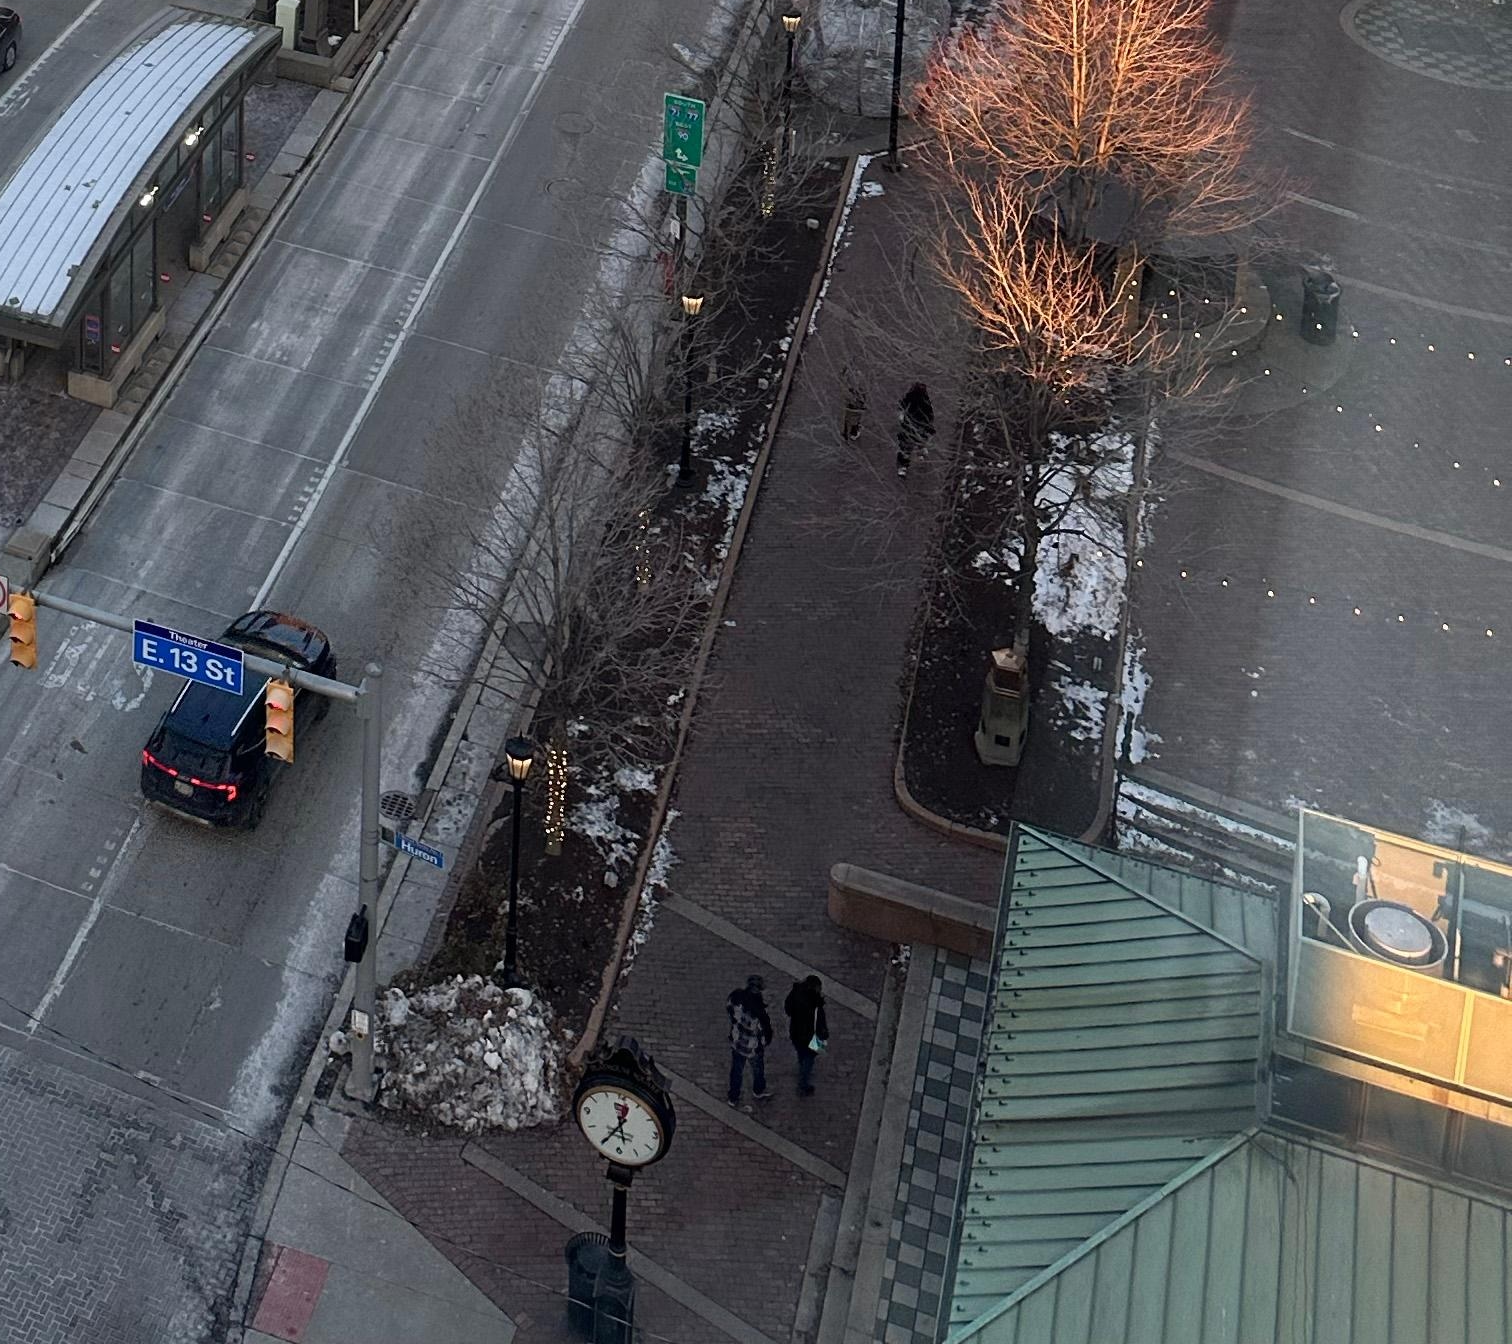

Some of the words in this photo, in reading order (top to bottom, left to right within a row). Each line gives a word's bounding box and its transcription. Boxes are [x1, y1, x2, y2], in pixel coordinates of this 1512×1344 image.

[168, 630, 209, 650] Theater
[142, 638, 165, 664] E.
[170, 648, 198, 674] 13
[205, 659, 235, 687] St
[400, 838, 438, 865] Huron
